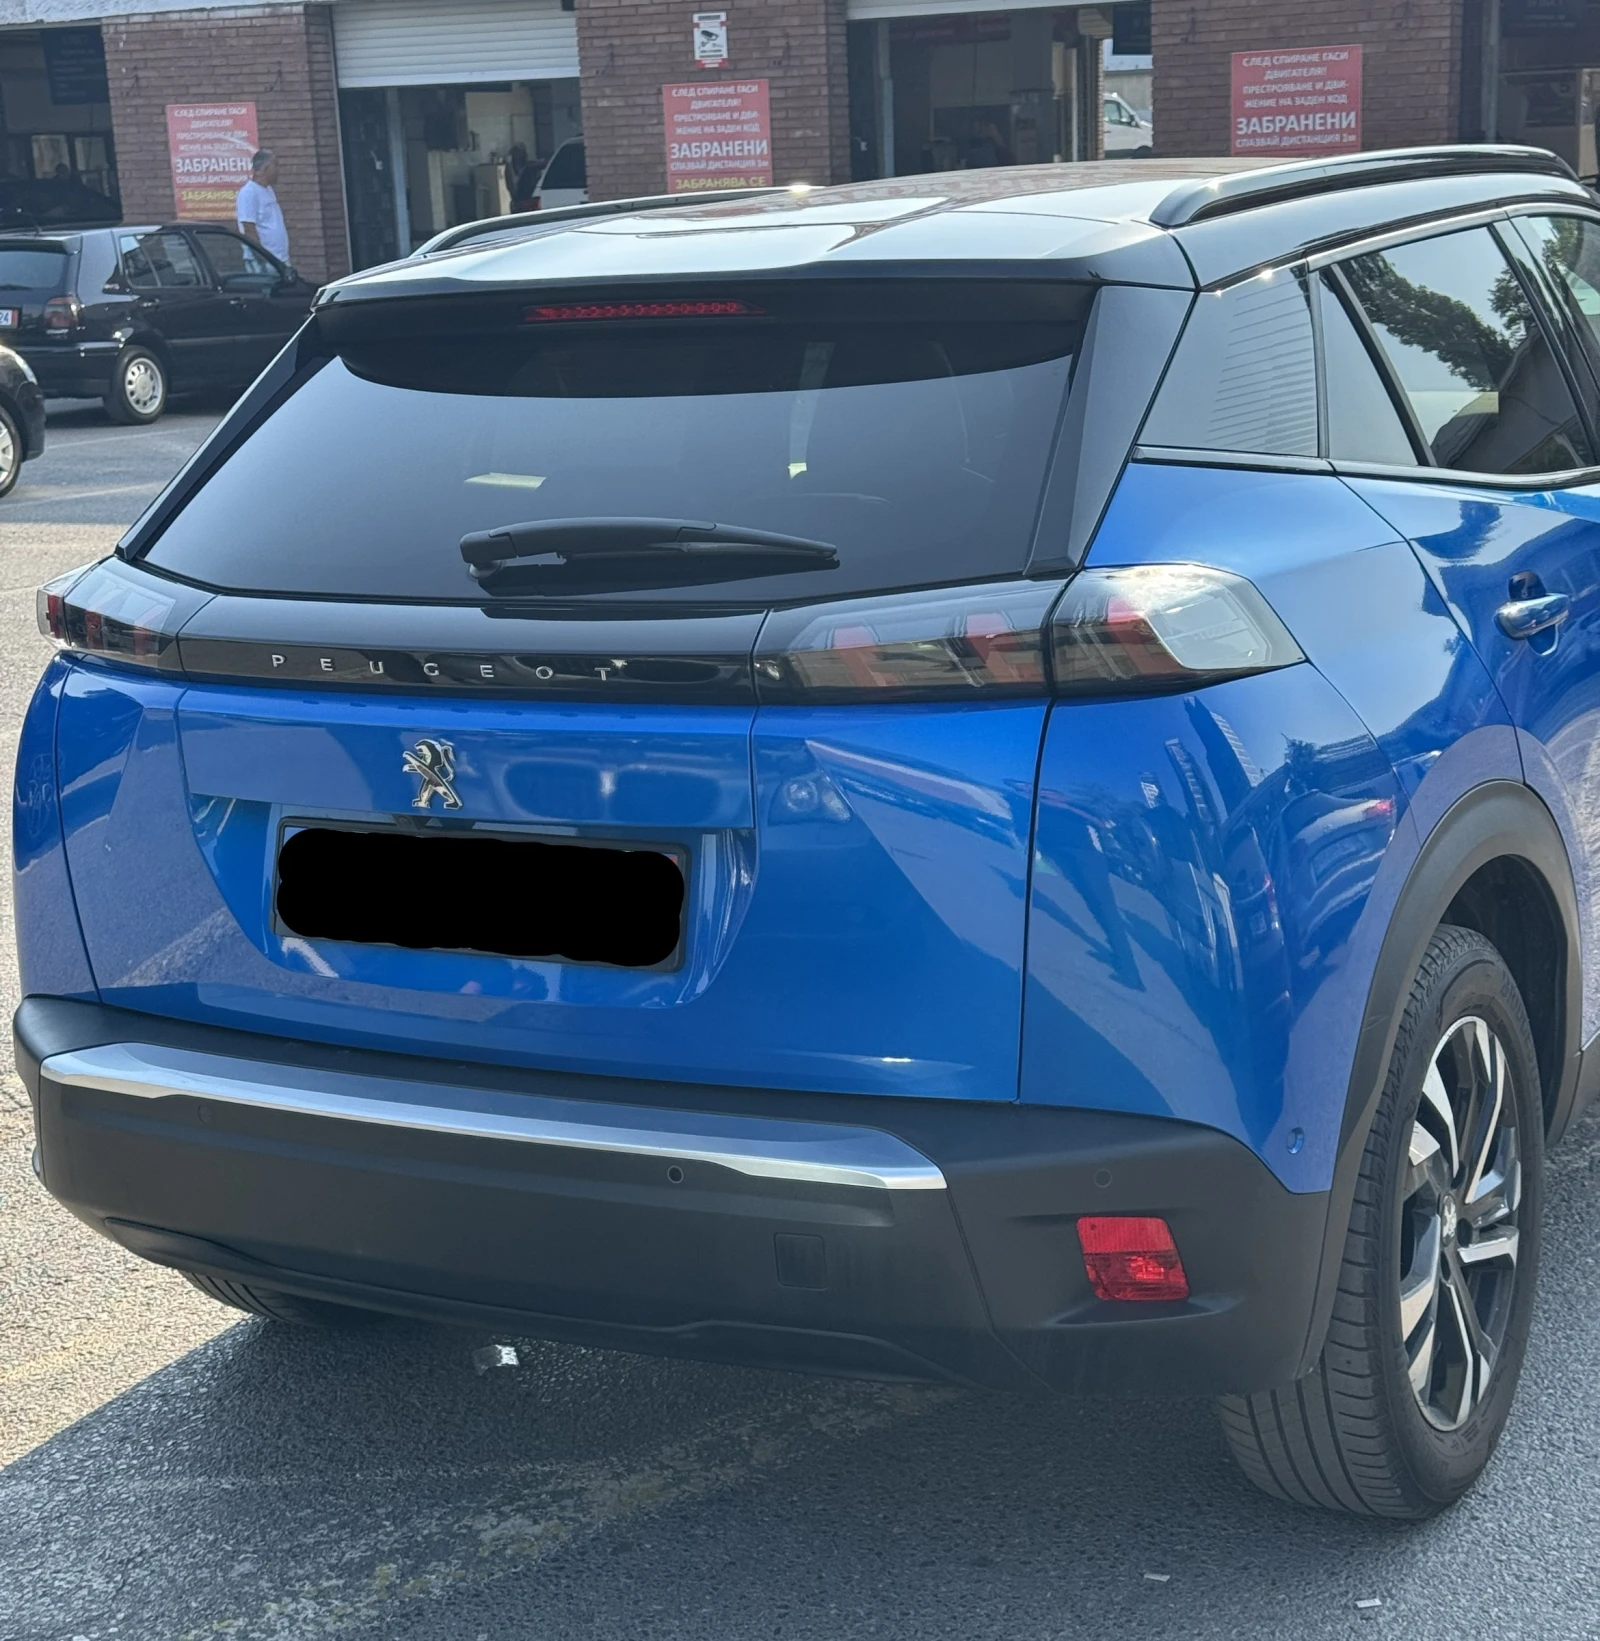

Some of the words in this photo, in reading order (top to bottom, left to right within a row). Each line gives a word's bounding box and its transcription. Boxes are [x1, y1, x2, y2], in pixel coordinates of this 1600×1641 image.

[1243, 58, 1271, 66] СЛЕД
[1273, 54, 1319, 64] СПИРАНЕ
[672, 88, 696, 97] СЛЕД
[1278, 98, 1292, 106] НА
[1295, 96, 1325, 106] ЗАДЕН
[1236, 112, 1356, 134] ЗАБРАНЕНИ
[670, 140, 768, 158] ЗАБРАНЕНИ
[676, 177, 746, 189] ЗАБРАНЯВА
[749, 176, 766, 186] СЕ
[271, 653, 612, 682] PEUGEOT
